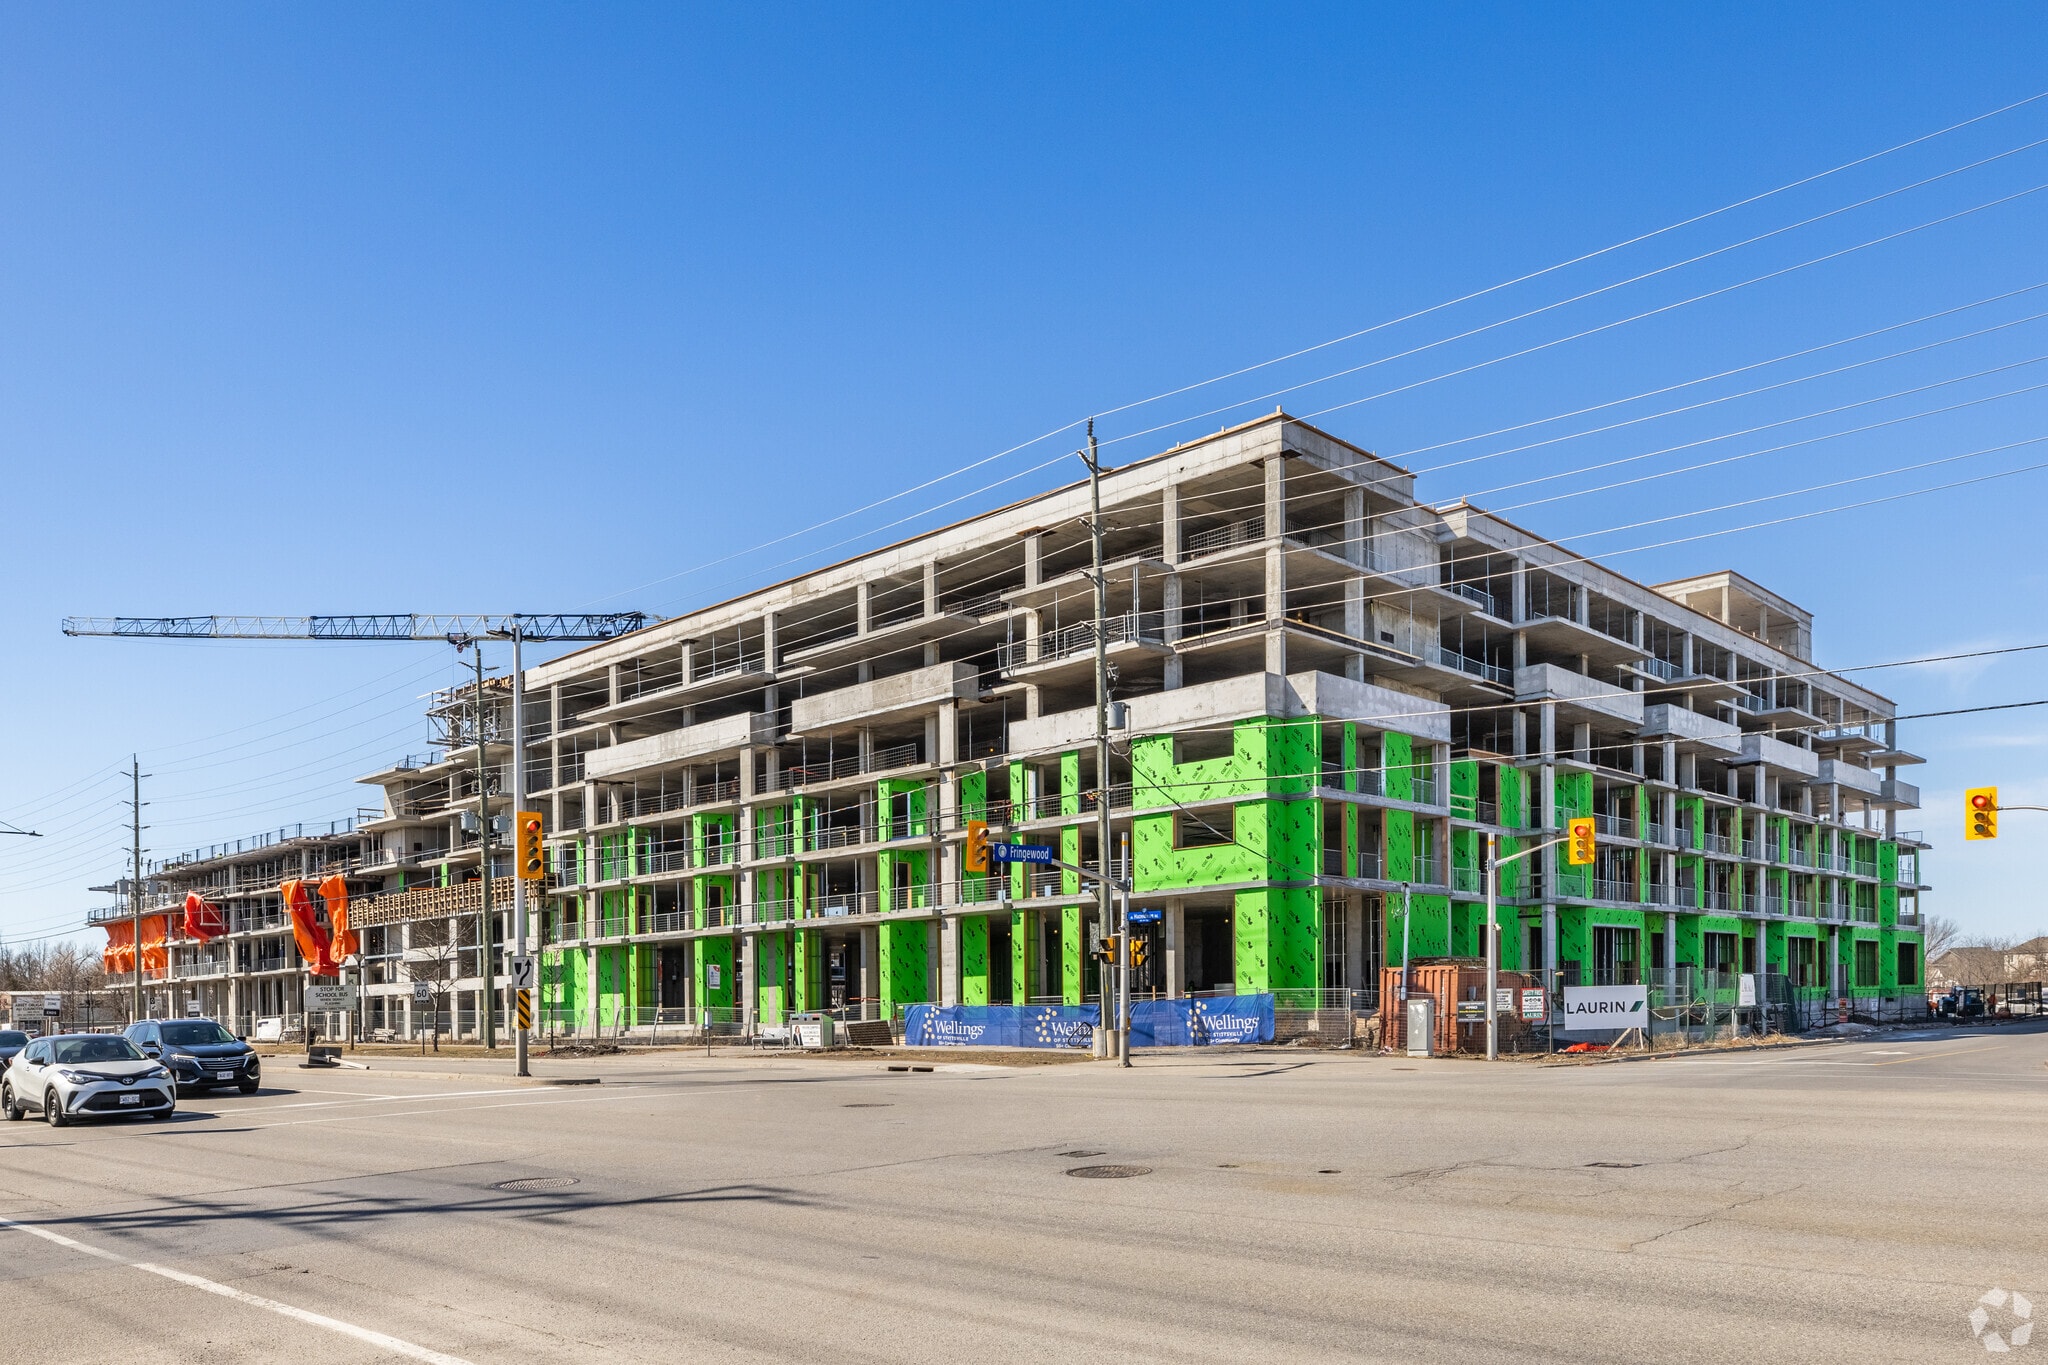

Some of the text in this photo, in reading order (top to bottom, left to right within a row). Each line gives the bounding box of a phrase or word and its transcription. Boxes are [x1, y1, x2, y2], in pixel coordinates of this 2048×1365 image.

[1010, 845, 1050, 862] Fringewood
[416, 989, 427, 998] 60
[1566, 1001, 1626, 1015] LAURIN
[935, 1020, 984, 1040] Wellings
[1202, 1014, 1258, 1034] Wellings
